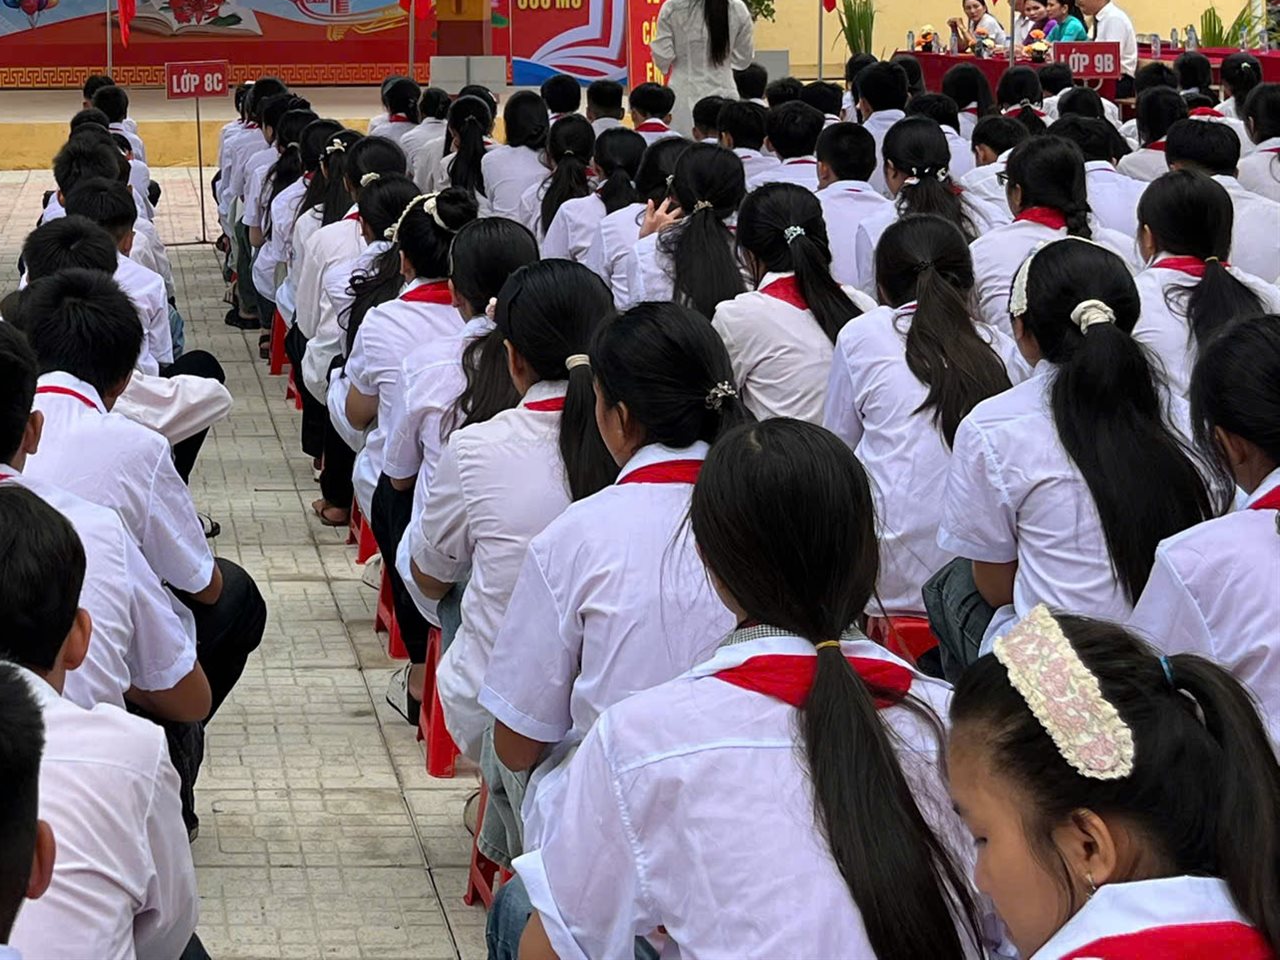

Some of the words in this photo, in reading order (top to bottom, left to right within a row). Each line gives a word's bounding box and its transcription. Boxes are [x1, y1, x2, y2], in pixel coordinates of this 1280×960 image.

[1093, 53, 1114, 73] 9B
[172, 69, 200, 94] LỚP
[204, 72, 223, 92] 8C
